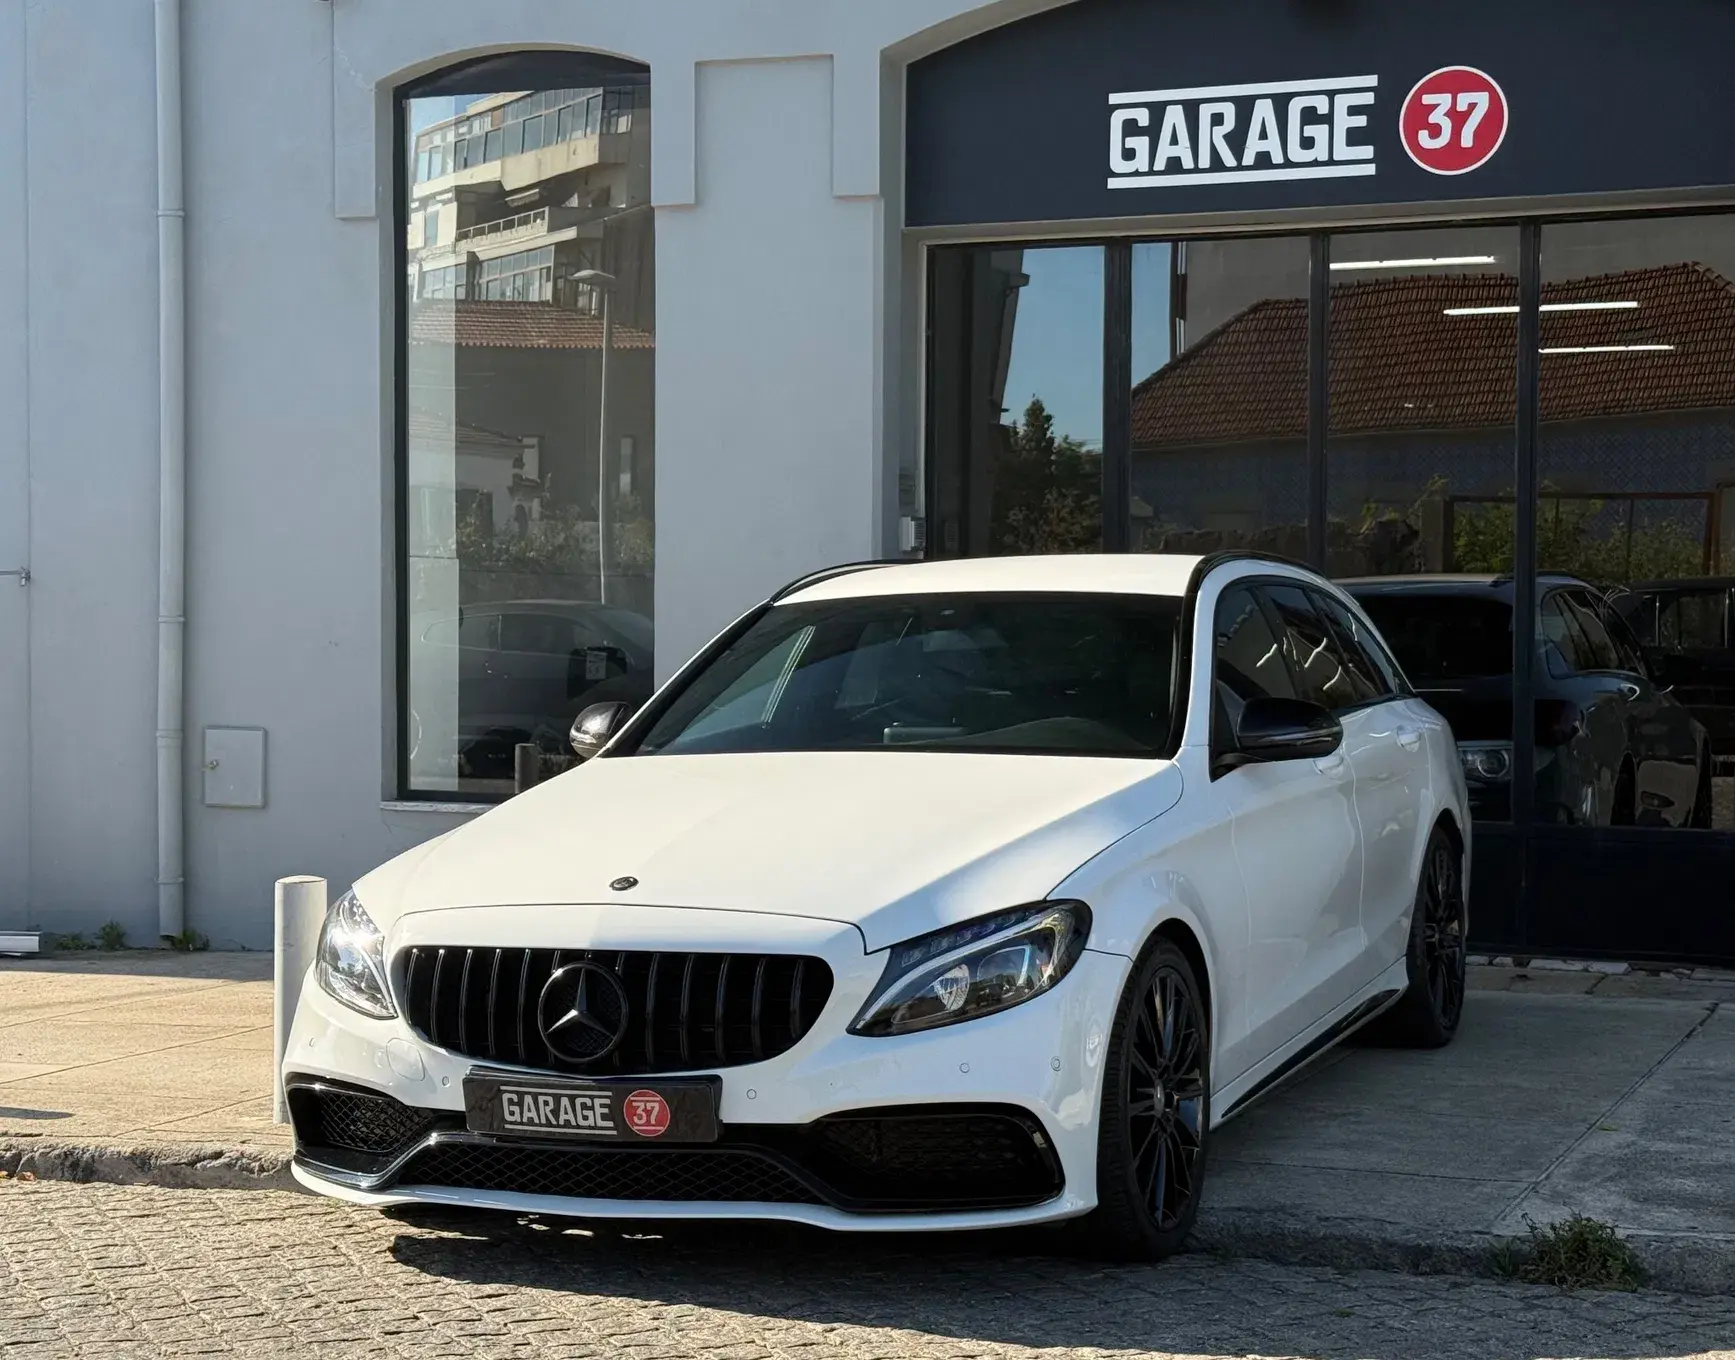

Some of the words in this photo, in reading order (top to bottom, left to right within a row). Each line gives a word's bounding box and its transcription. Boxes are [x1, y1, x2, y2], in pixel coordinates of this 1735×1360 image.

[1109, 91, 1375, 174] GARAGE
[1417, 91, 1490, 149] 37
[501, 1091, 614, 1128] GARAGE
[632, 1101, 660, 1126] 37
